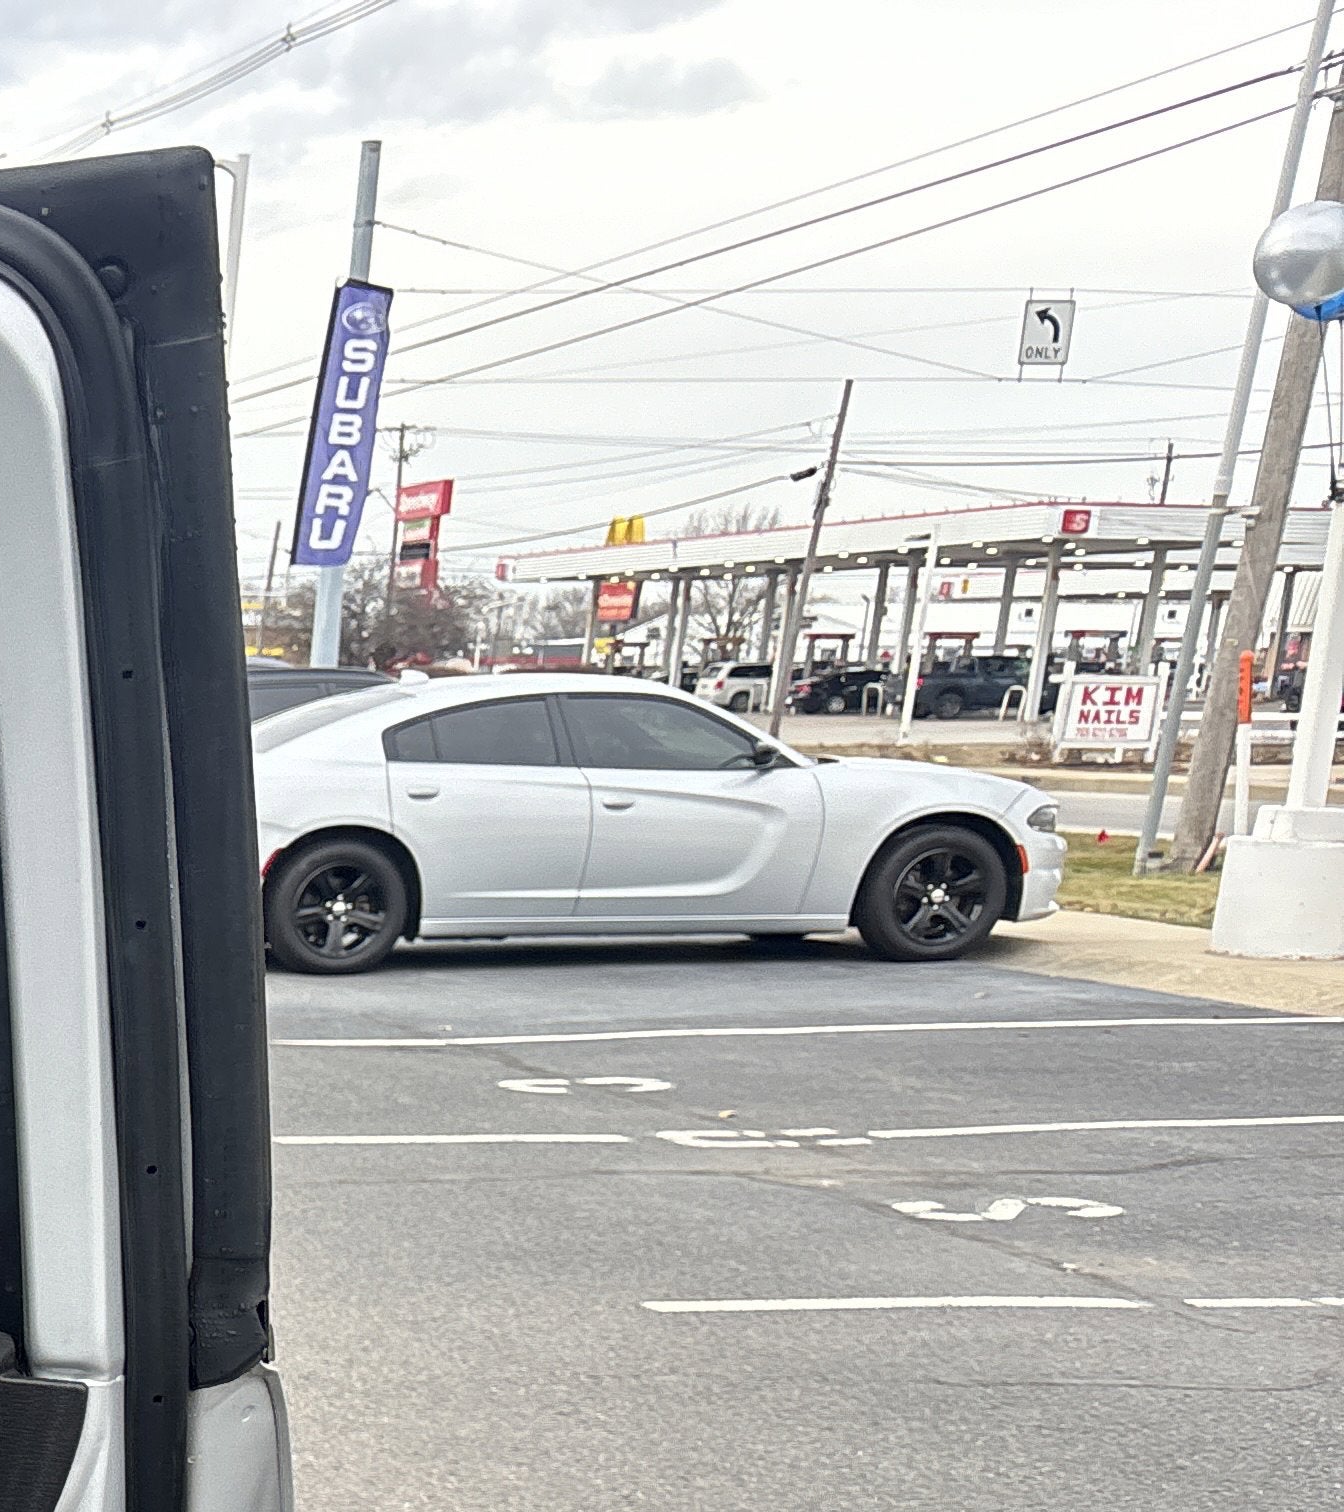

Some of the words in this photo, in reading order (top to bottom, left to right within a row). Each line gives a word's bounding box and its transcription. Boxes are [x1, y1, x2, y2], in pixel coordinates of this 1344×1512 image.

[1025, 345, 1062, 360] ONLY
[308, 338, 378, 550] SUBARU
[1081, 686, 1144, 706] KIM
[1078, 709, 1142, 725] NAILS
